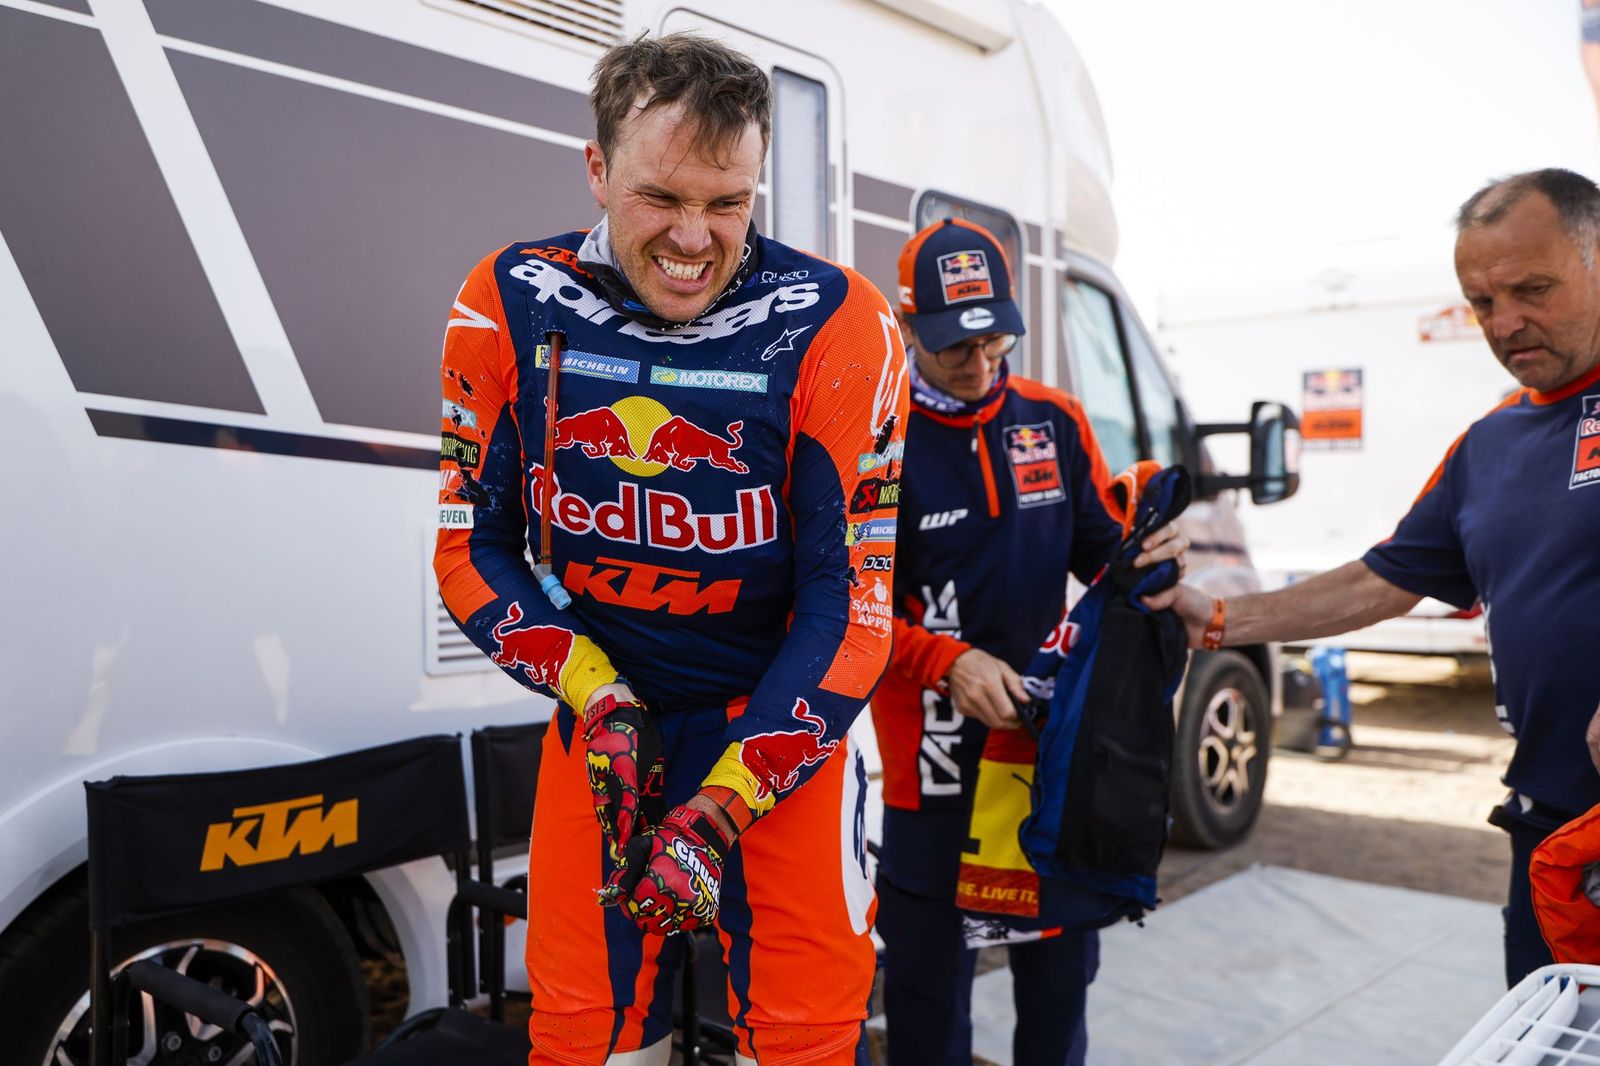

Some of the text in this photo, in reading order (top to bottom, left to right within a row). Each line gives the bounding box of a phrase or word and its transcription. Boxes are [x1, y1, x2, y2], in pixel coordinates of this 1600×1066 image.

[562, 357, 630, 375] MICHELIN
[678, 371, 762, 390] MOTOREX
[529, 462, 778, 554] Red Bull
[919, 508, 969, 531] WP
[563, 556, 743, 616] KTM
[200, 794, 359, 872] KTM
[981, 886, 1018, 901] LIVE
[1020, 889, 1038, 904] IT.
